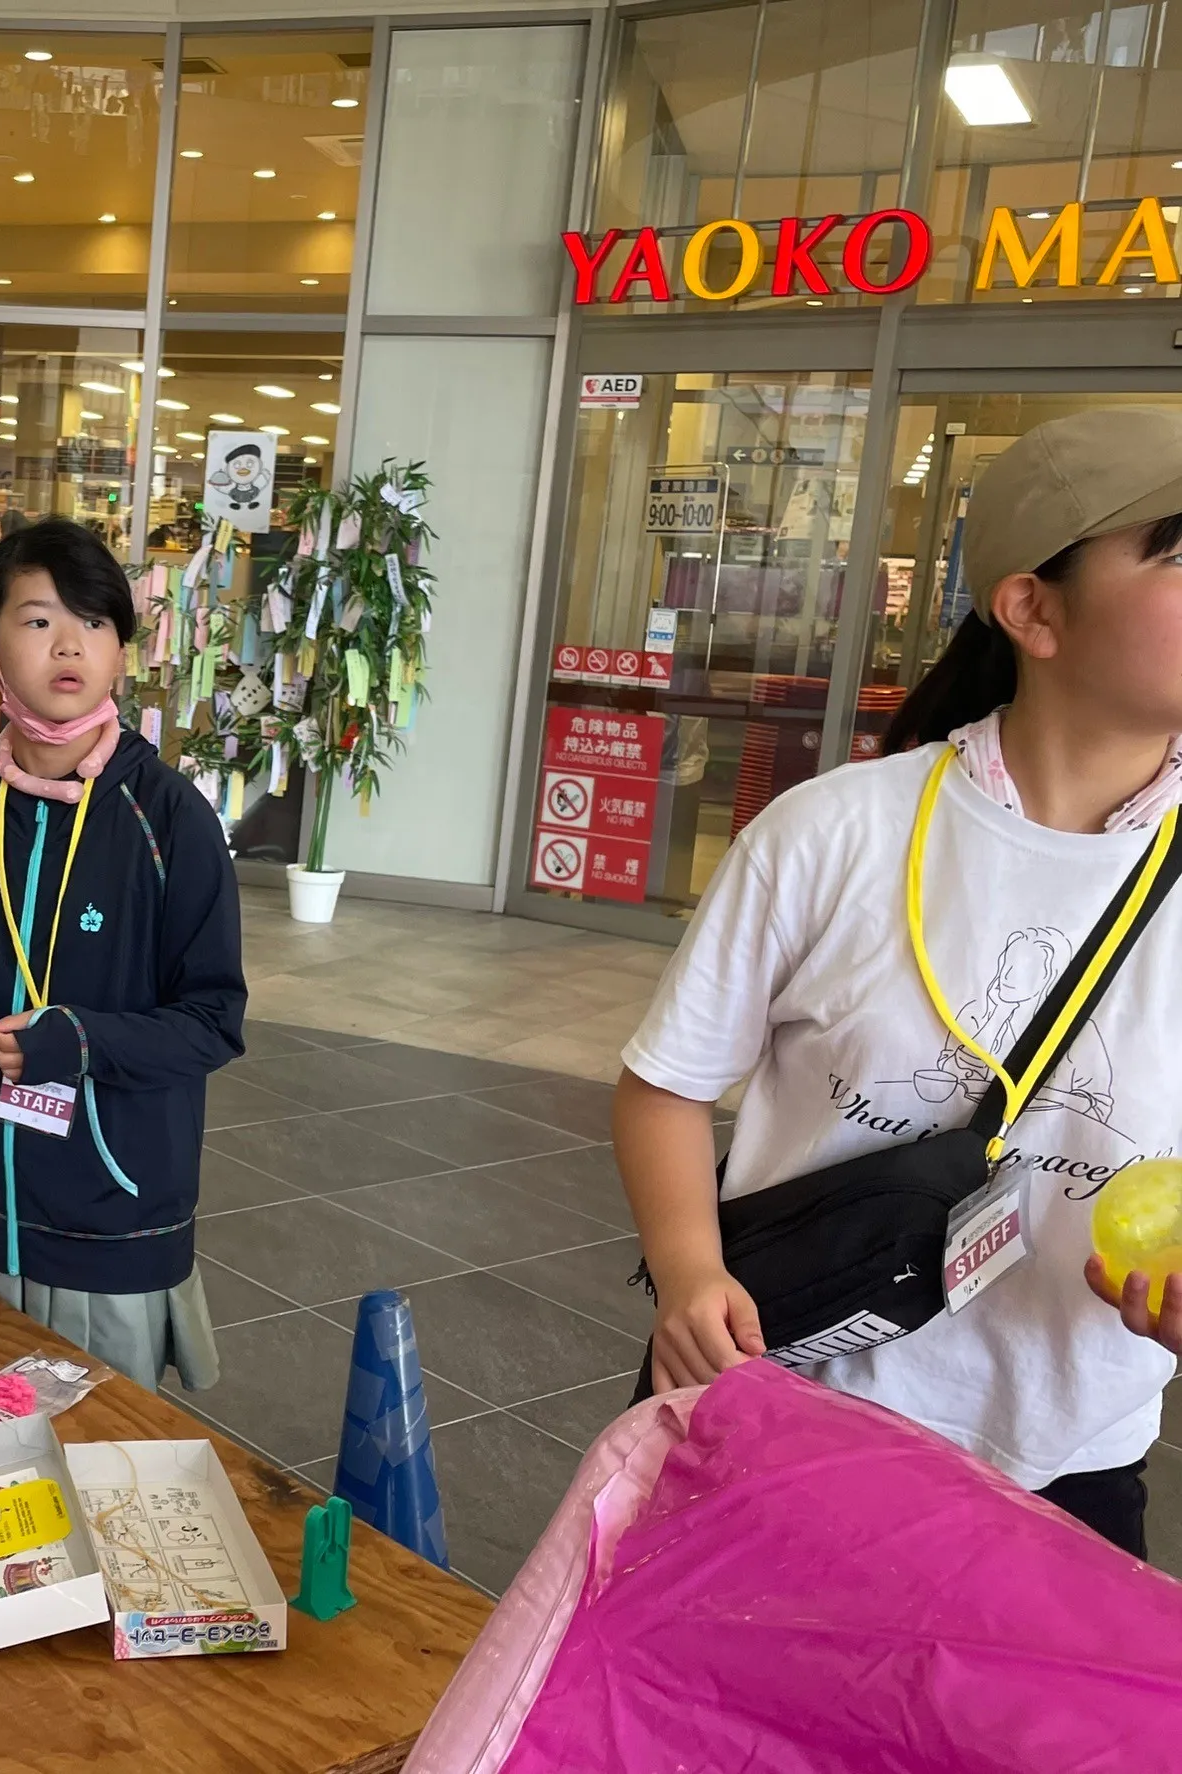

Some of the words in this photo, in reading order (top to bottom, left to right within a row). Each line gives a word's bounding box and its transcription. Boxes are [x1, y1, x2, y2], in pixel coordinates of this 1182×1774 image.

[561, 208, 933, 304] YAOKO
[600, 378, 637, 392] AED
[571, 716, 638, 739] 危険物品
[563, 736, 642, 760] 持込み厳禁
[556, 752, 567, 761] NO
[568, 753, 612, 767] DANGEROUS
[613, 758, 647, 771] OBJECTS
[599, 797, 646, 818] 火気厳禁
[606, 815, 618, 824] NO
[619, 816, 635, 827] FIRE
[591, 871, 603, 880] NO
[603, 872, 637, 885] SMOKING
[9, 1089, 66, 1116] STAFF
[828, 1074, 913, 1136] What
[955, 1219, 1011, 1280] STAFF
[128, 1620, 271, 1647] らくらくヨーヨーセット
